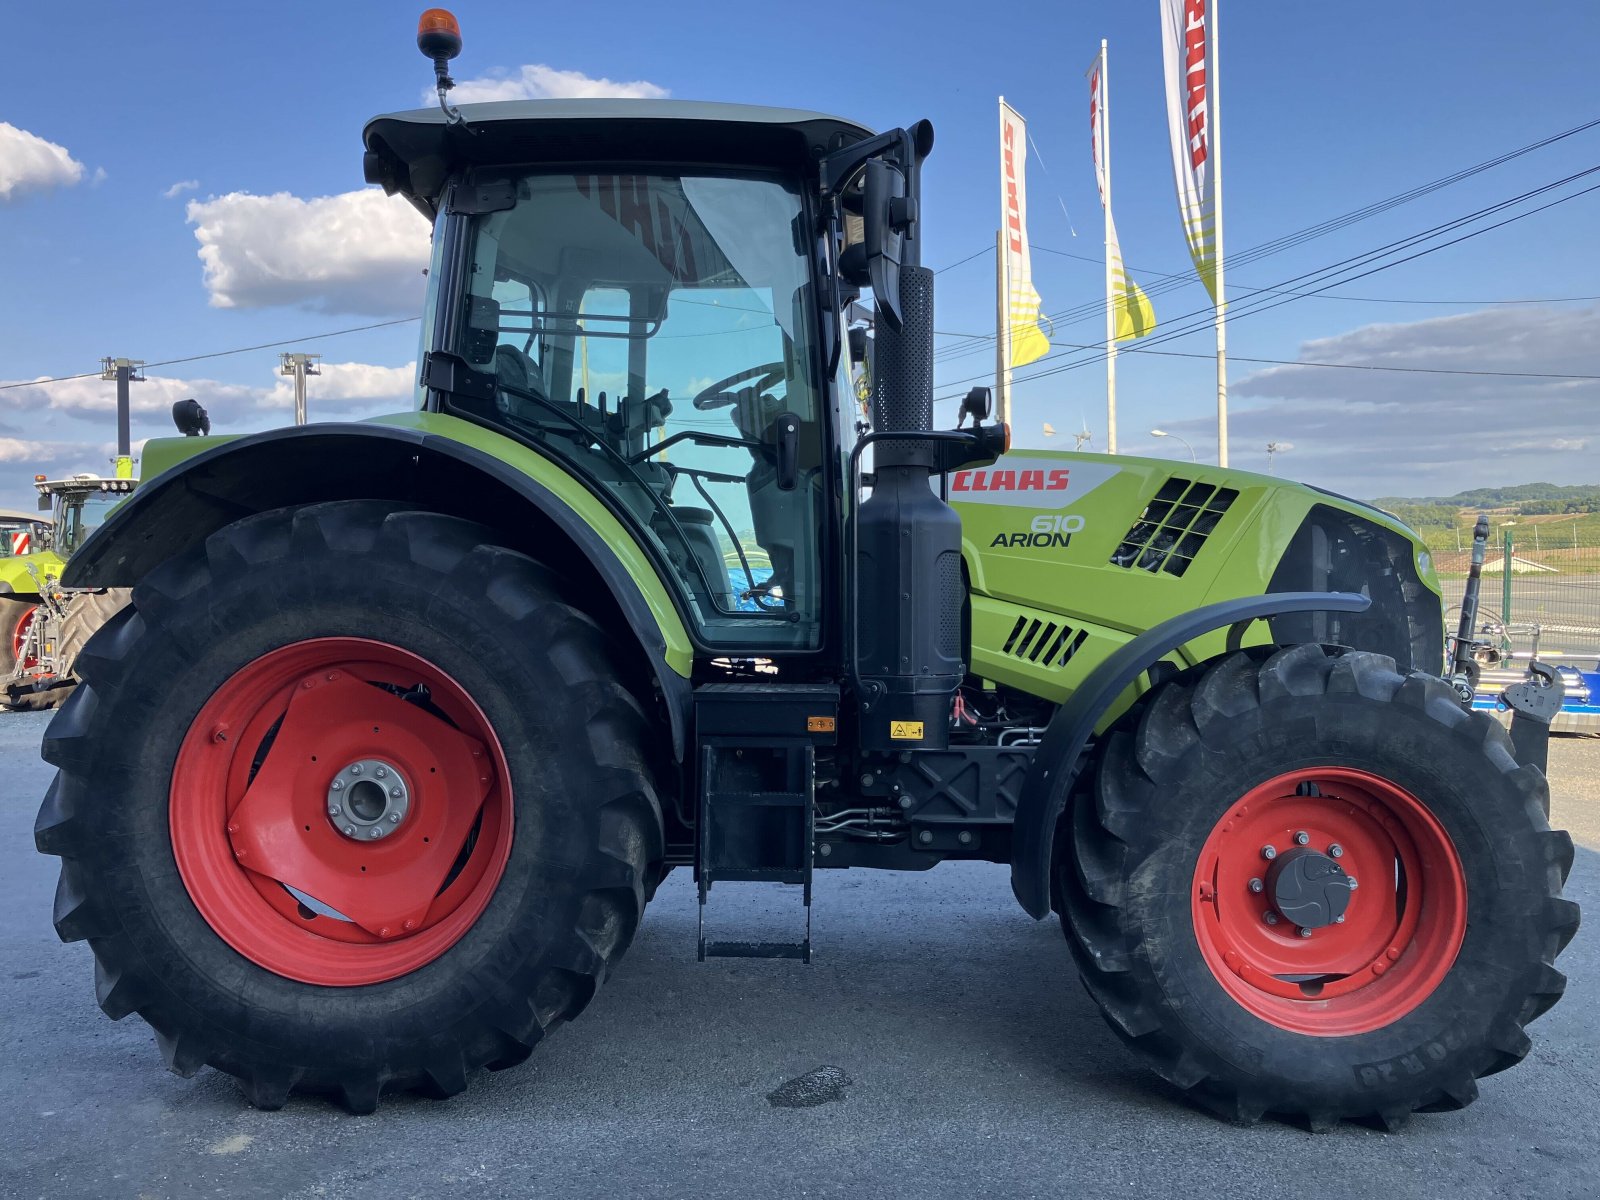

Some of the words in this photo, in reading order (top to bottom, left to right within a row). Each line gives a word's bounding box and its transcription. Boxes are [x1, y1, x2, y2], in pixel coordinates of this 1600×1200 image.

[951, 469, 1070, 492] CLAAS
[1030, 514, 1086, 533] 610
[989, 532, 1072, 548] ARION
